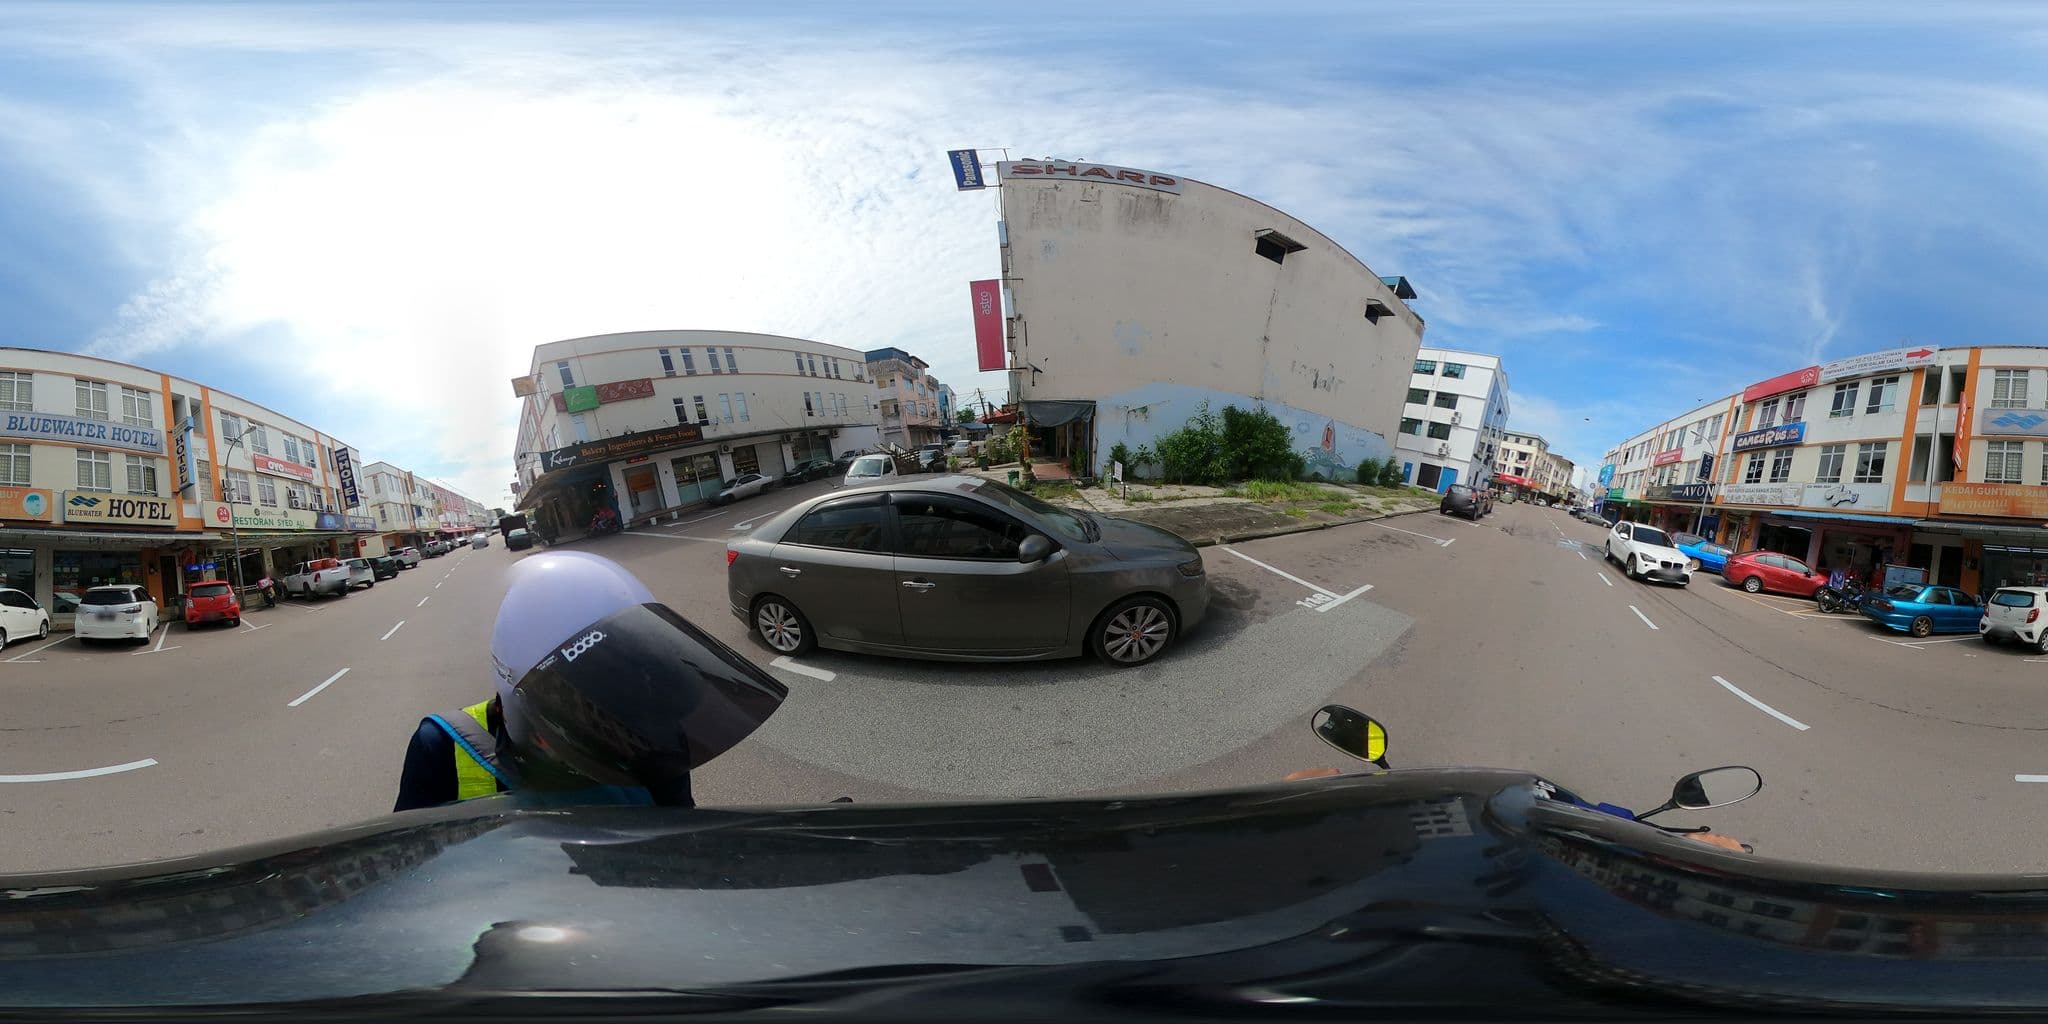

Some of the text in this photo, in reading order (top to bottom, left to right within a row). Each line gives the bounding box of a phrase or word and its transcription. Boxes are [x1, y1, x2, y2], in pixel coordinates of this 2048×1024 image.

[956, 151, 977, 186] Panasonic
[1011, 164, 1177, 186] SHARP
[980, 291, 992, 315] astro
[6, 415, 158, 447] BLUEWATER HOTEL
[581, 447, 607, 457] Bakery
[608, 438, 646, 451] Ingredients
[175, 435, 188, 485] HOTEL
[268, 461, 285, 472] OYO
[1702, 455, 1712, 479] AVON
[338, 460, 358, 507] HOTEL
[1682, 485, 1714, 497] AVON
[1945, 487, 1974, 496] KEDAI
[1976, 487, 2022, 497] GUNTING
[67, 499, 172, 520] BLUEWATER HOTEL
[233, 516, 274, 526] RESTORAN
[277, 518, 293, 527] SYED
